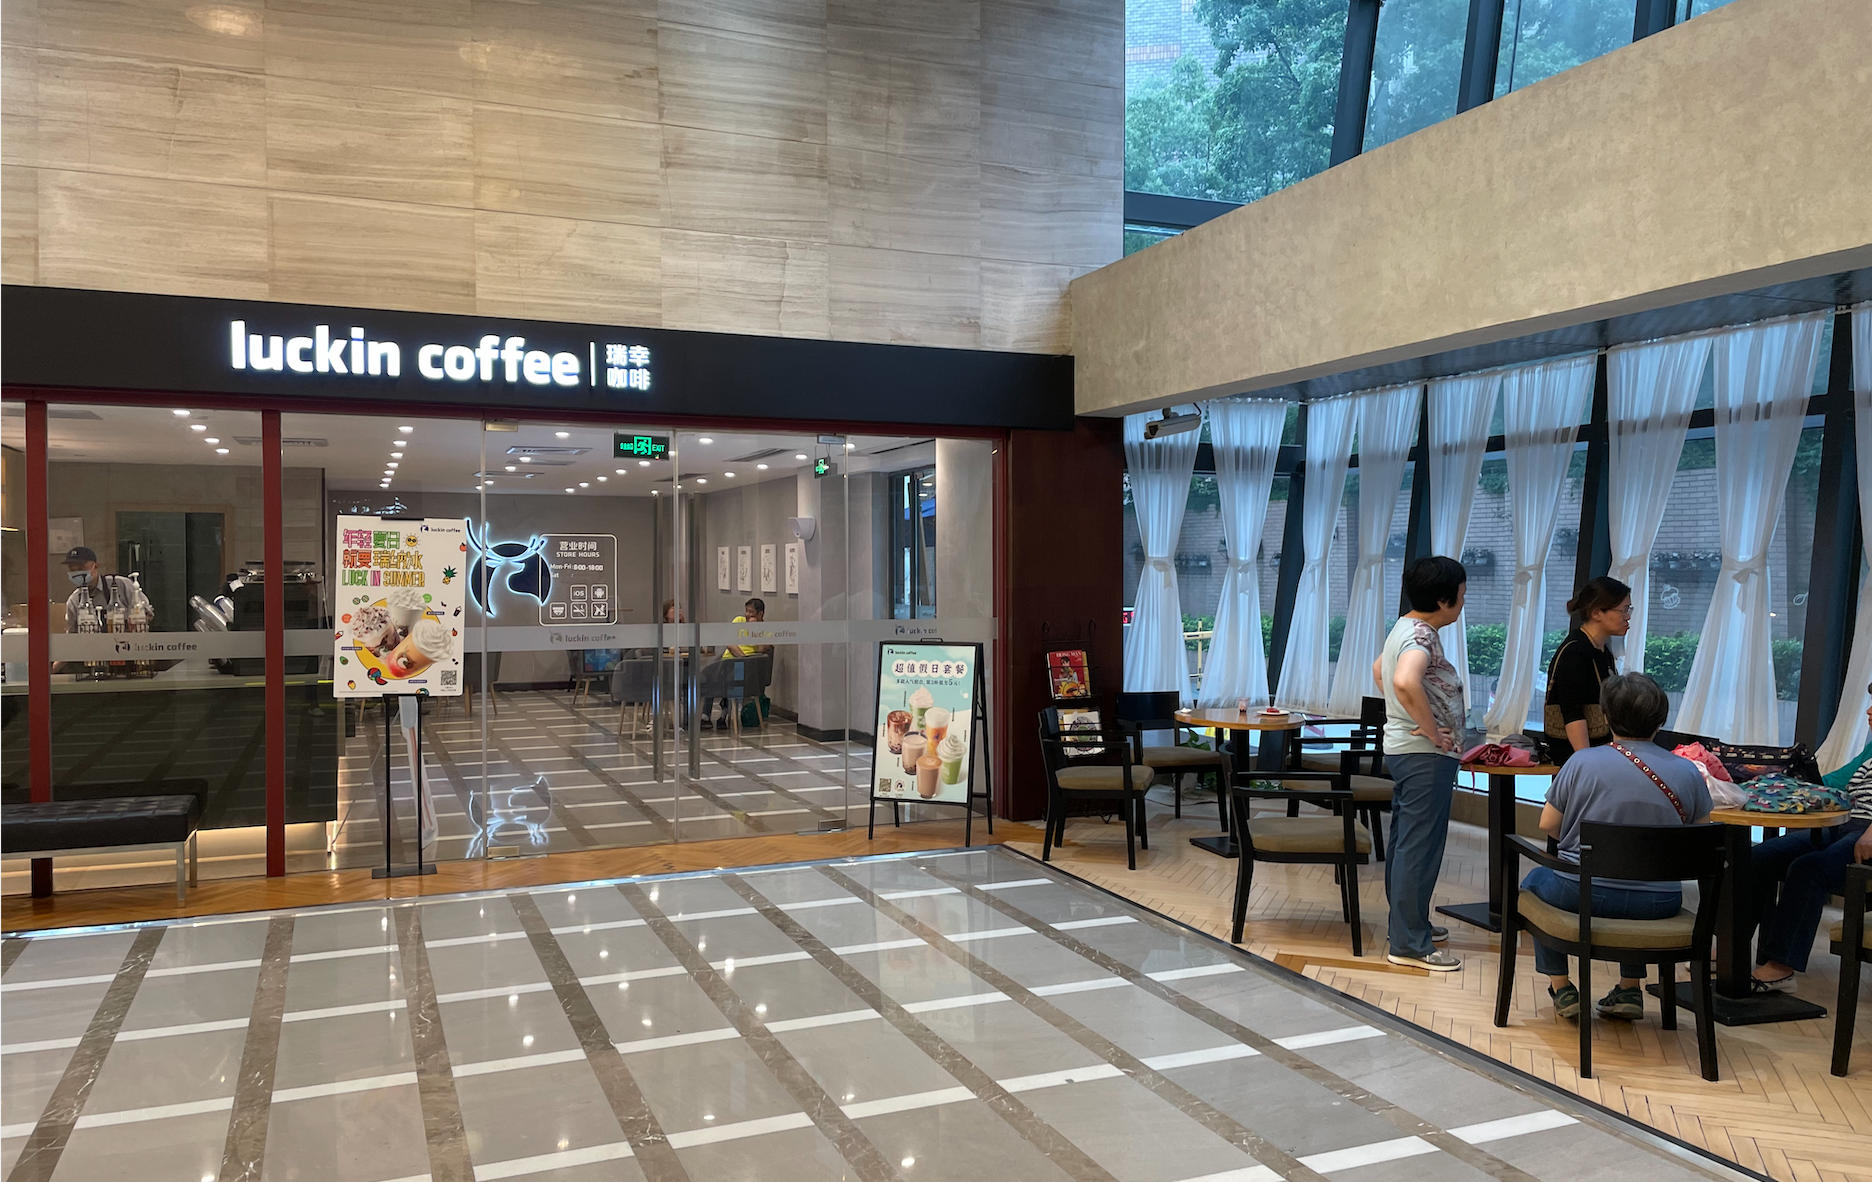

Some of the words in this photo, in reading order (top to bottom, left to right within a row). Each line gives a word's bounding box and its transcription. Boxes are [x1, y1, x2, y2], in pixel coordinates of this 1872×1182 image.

[230, 319, 401, 377] luckin
[417, 335, 580, 387] coffee
[605, 343, 651, 367] 瑞幸
[606, 367, 651, 391] 咖啡
[652, 444, 665, 452] EXIT
[559, 541, 597, 551] 营业时间
[341, 569, 369, 587] LUCK
[370, 570, 381, 587] IN
[382, 570, 426, 588] SUMMER
[565, 634, 590, 642] luckin
[774, 630, 797, 638] coffee
[166, 642, 197, 651] coffee
[894, 662, 965, 675] 超值假日套餐
